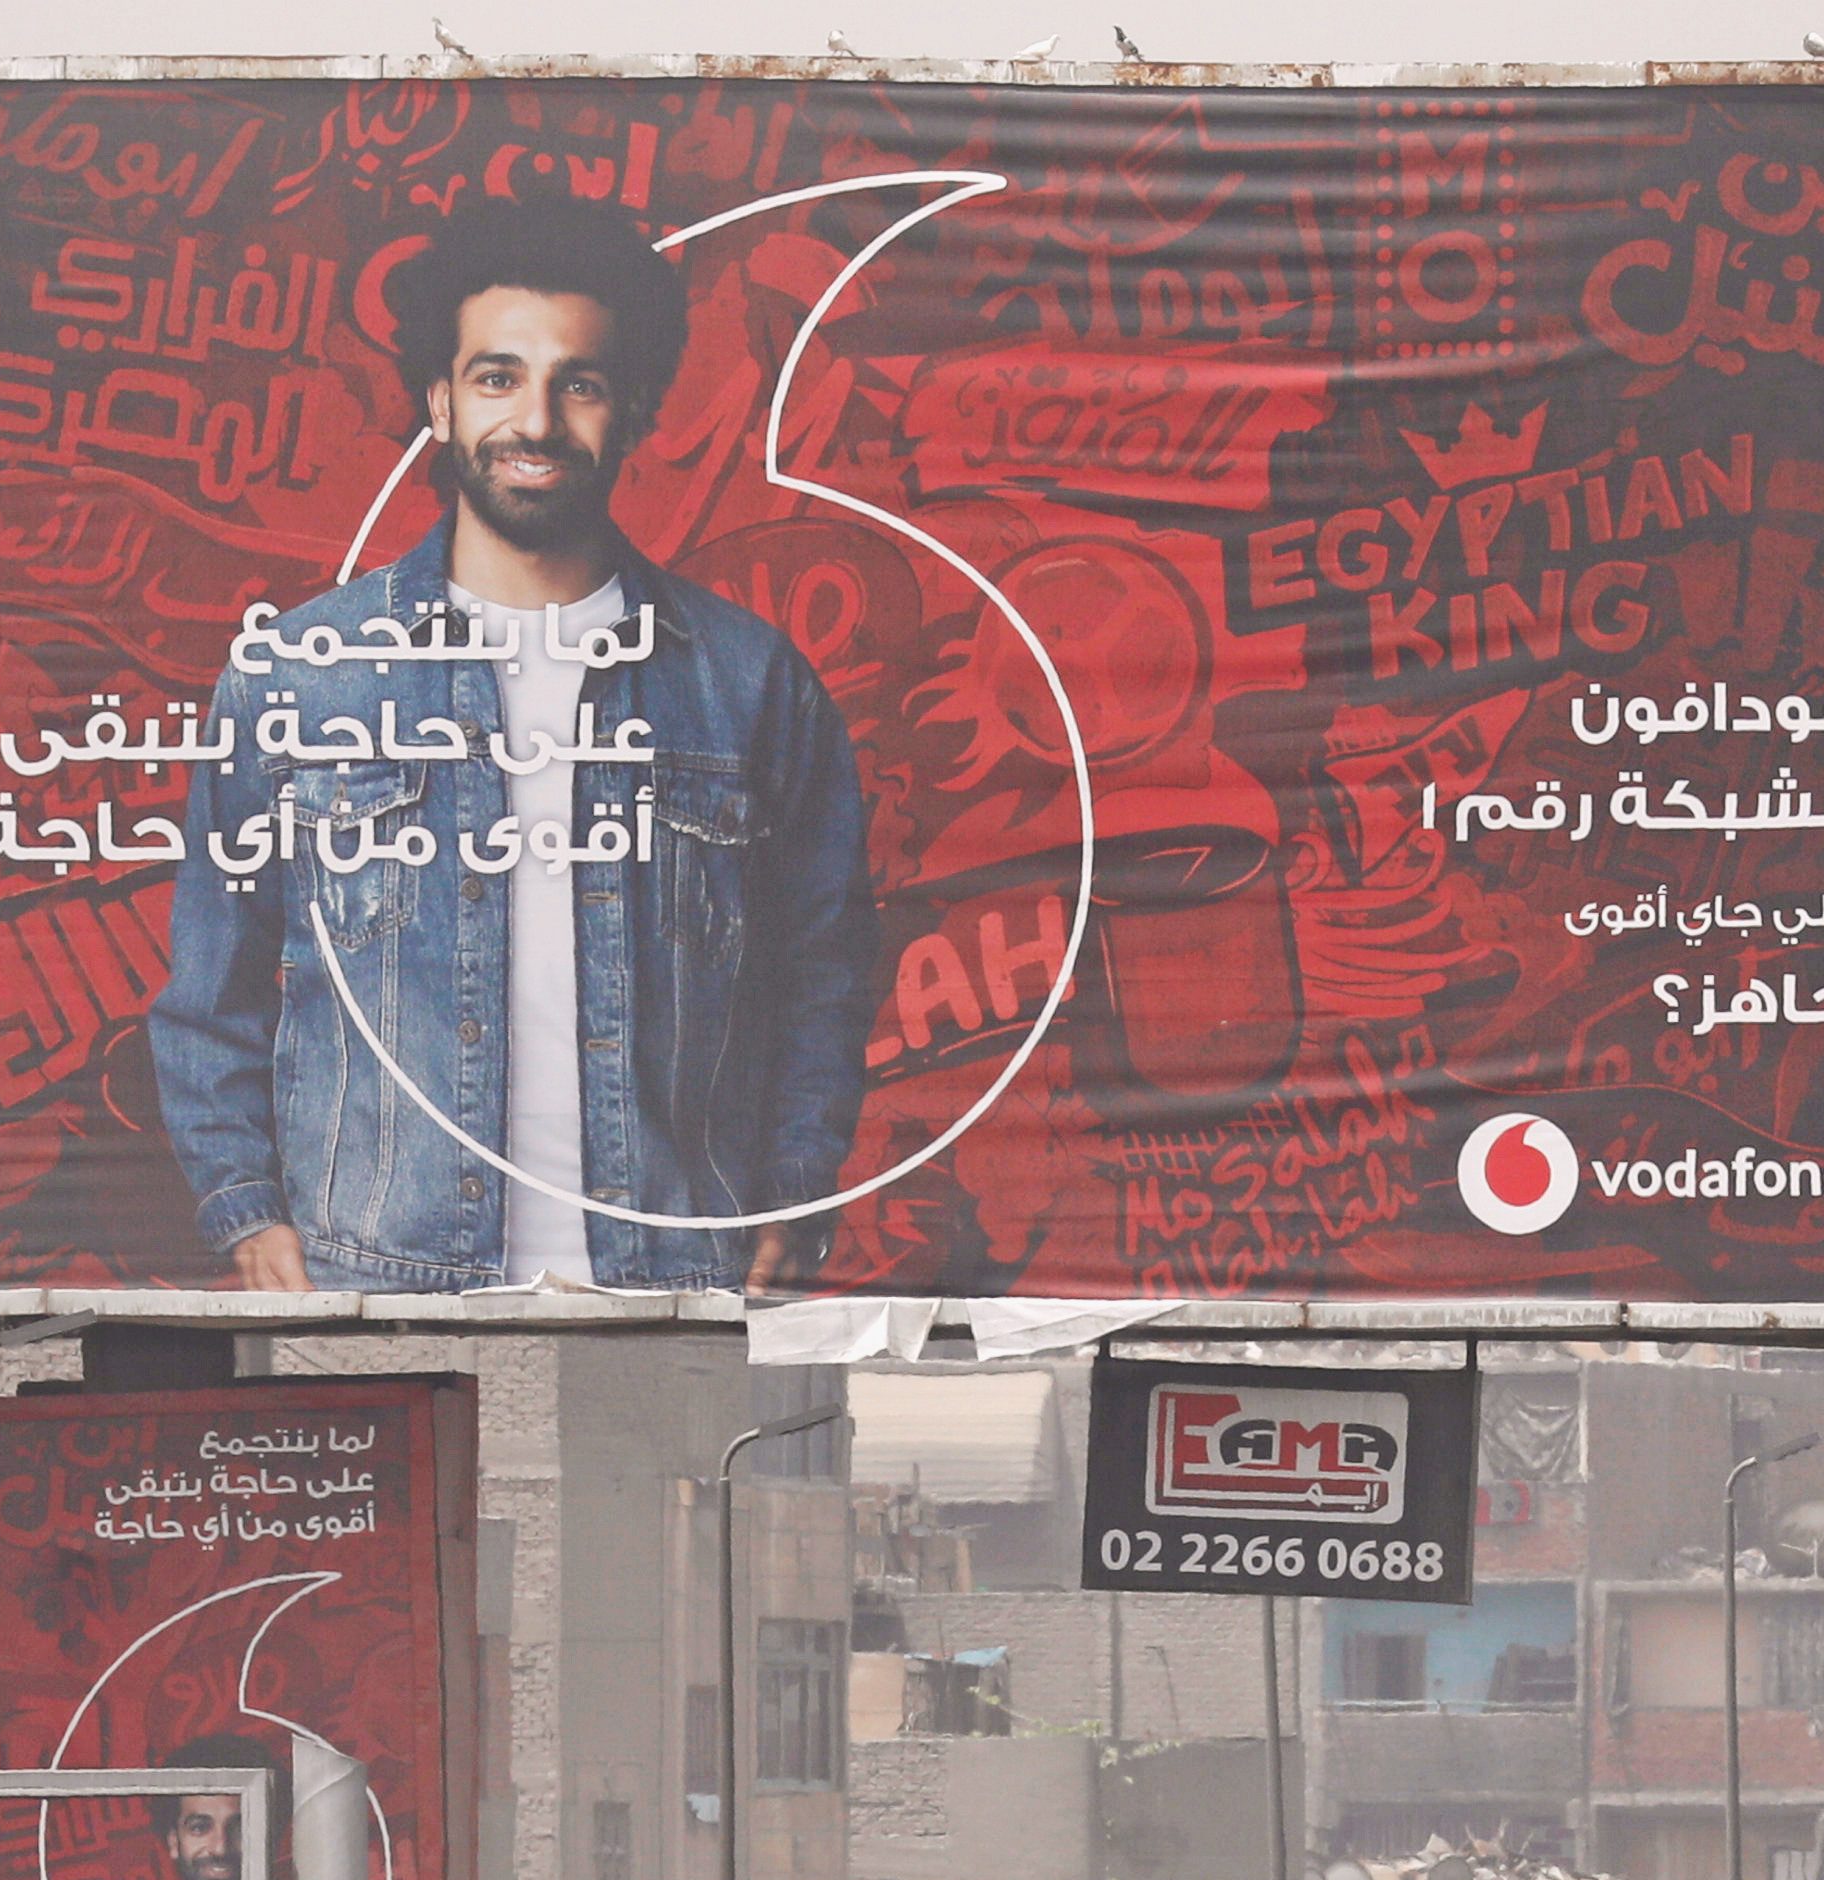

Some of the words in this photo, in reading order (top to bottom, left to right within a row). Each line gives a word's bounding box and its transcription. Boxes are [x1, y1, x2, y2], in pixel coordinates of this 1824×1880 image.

[1248, 434, 1753, 610] EGYPTIAN
[230, 601, 520, 675] بنتجمع
[541, 601, 656, 669] لما
[1367, 561, 1652, 678] KING
[0, 694, 235, 776] بتبقى
[256, 694, 468, 775] حاجة
[490, 702, 656, 775] على
[207, 782, 300, 893] أي
[317, 798, 437, 873] من
[459, 787, 656, 875] أقوى
[1455, 780, 1593, 842] رقم
[1564, 884, 1668, 936] أقوى
[1676, 894, 1763, 947] جاي
[199, 1429, 319, 1459] بنتجمع
[329, 1426, 375, 1453] لما
[105, 1469, 202, 1505] بتبقى
[210, 1465, 297, 1500] حاجة
[306, 1467, 374, 1499] على
[94, 1511, 185, 1545] حاجة
[192, 1503, 229, 1551] أي
[237, 1510, 287, 1541] من
[295, 1500, 375, 1541] أقوى
[1101, 1528, 1162, 1572] 02
[1179, 1532, 1306, 1577] 2266
[1317, 1537, 1444, 1583] 0688
